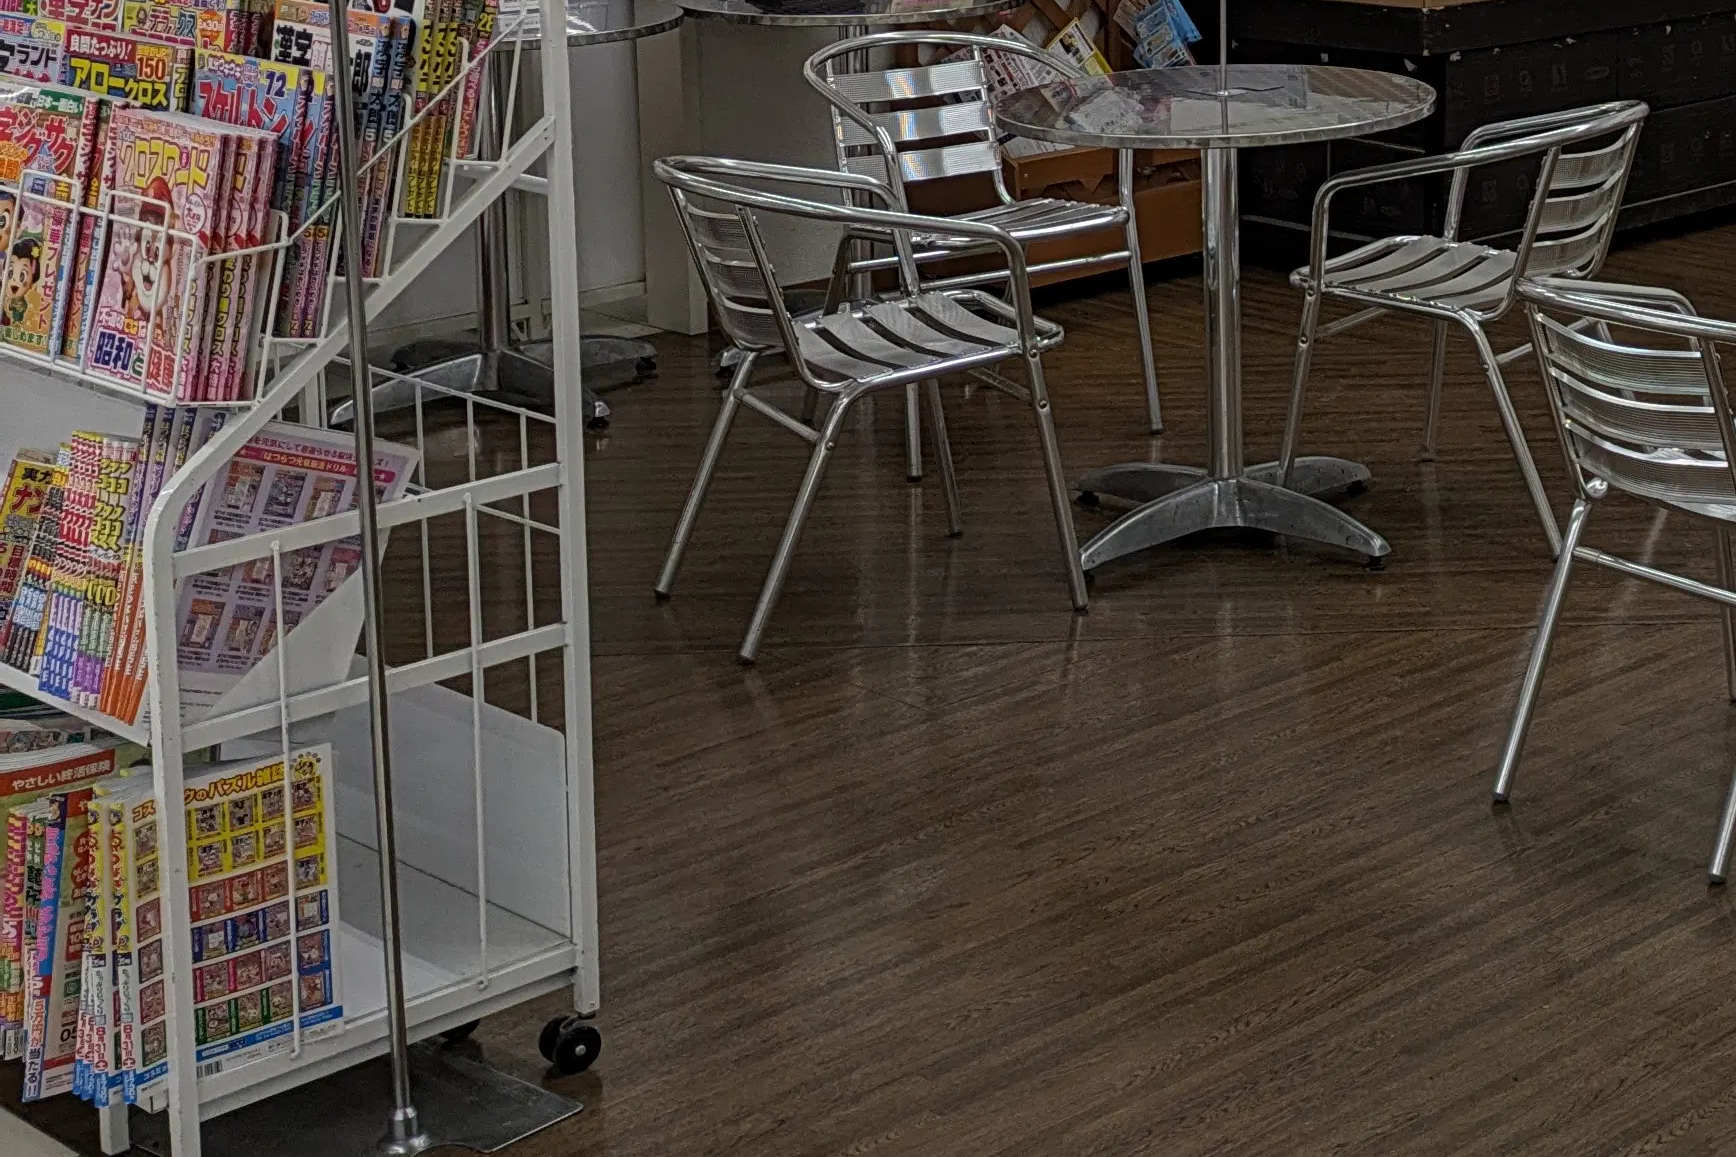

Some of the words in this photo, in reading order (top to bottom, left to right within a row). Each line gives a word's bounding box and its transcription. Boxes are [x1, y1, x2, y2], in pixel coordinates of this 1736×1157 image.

[69, 33, 132, 61] 良問たっぷり!
[69, 56, 169, 107] アロークロス
[136, 55, 167, 82] 150
[264, 70, 289, 99] 72
[118, 135, 211, 196] クロスワード
[10, 759, 113, 792] やさしい終活保険
